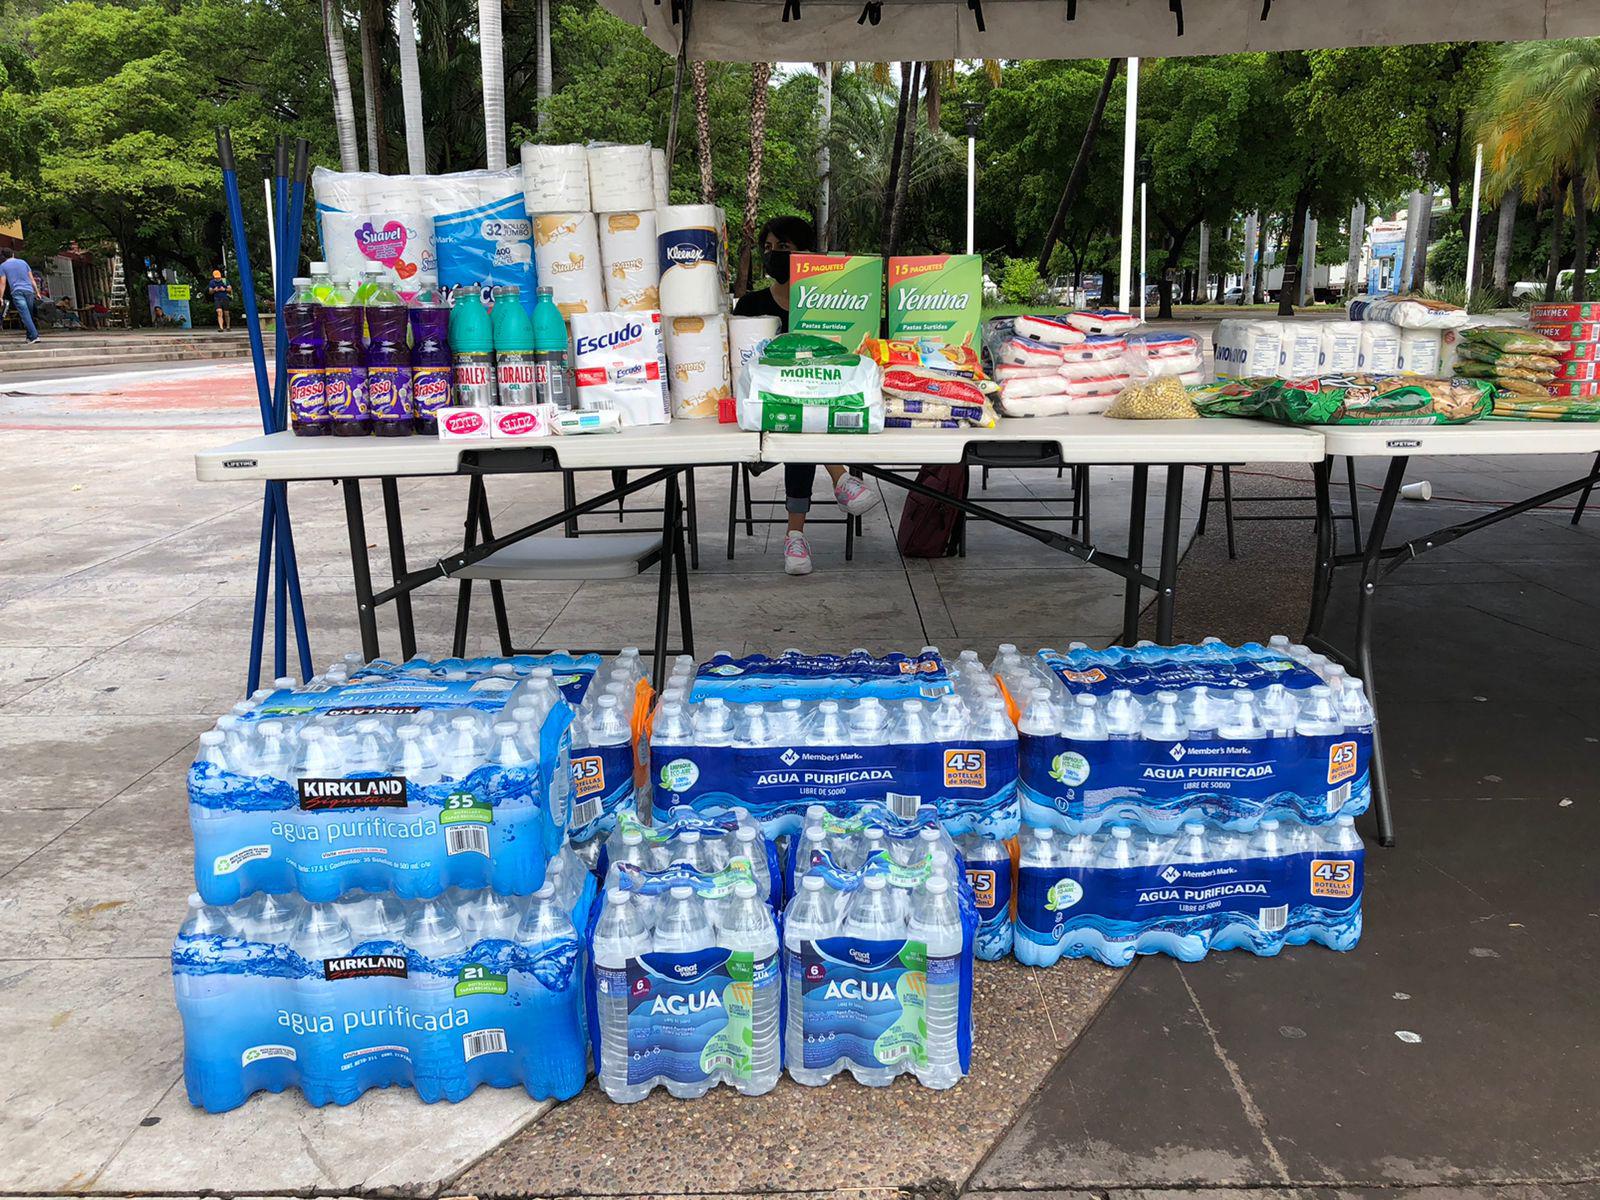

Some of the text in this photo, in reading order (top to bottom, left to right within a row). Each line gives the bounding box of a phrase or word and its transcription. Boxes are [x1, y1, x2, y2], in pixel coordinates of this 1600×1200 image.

[362, 226, 402, 245] Suavel
[486, 223, 502, 236] 32
[496, 247, 511, 255] 400
[667, 246, 705, 261] Kleenex
[551, 258, 584, 274] Suavel
[612, 258, 643, 271] Suavel
[796, 263, 844, 273] 15 PAQUETES
[895, 263, 943, 275] 15 PAQUETES
[797, 286, 869, 311] Yemina
[897, 288, 968, 311] Yemina
[802, 322, 847, 331] Pastas Surtidas
[903, 323, 948, 331] Pastas Surtidas
[577, 323, 642, 355] Escudo
[612, 337, 643, 351] Antibacterial
[617, 365, 642, 378] Escudo
[675, 361, 706, 373] Suavel
[780, 368, 842, 380] MORENA
[291, 381, 324, 400] Brasso
[414, 380, 446, 398] Brasso
[449, 416, 479, 430] ZOTE
[503, 416, 532, 430] ZOTE
[802, 753, 839, 761] Member's
[1188, 746, 1247, 755] Member's Mark
[1332, 745, 1354, 764] 45
[947, 753, 982, 771] 45
[572, 760, 599, 780] 45
[1143, 765, 1273, 779] AGUA PURIFICADA
[757, 770, 892, 785] AGUA PURIFICADA
[303, 780, 403, 797] KIRKLAND
[828, 787, 846, 796] SODIO
[448, 795, 474, 809] 35
[272, 816, 437, 844] agua purificada
[1183, 867, 1235, 878] Member's Mark
[1314, 864, 1350, 881] 45
[1139, 884, 1267, 902] AGUA PURIFICADA
[1179, 904, 1197, 912] LIBRE
[849, 949, 870, 959] Great
[328, 957, 405, 972] KIRKLAND
[674, 963, 698, 973] Great
[810, 965, 819, 975] 6
[464, 968, 483, 979] 21
[636, 980, 644, 990] 6
[823, 978, 895, 1001] AGUA
[650, 989, 723, 1016] AGUA
[277, 1004, 469, 1035] agua purificada
